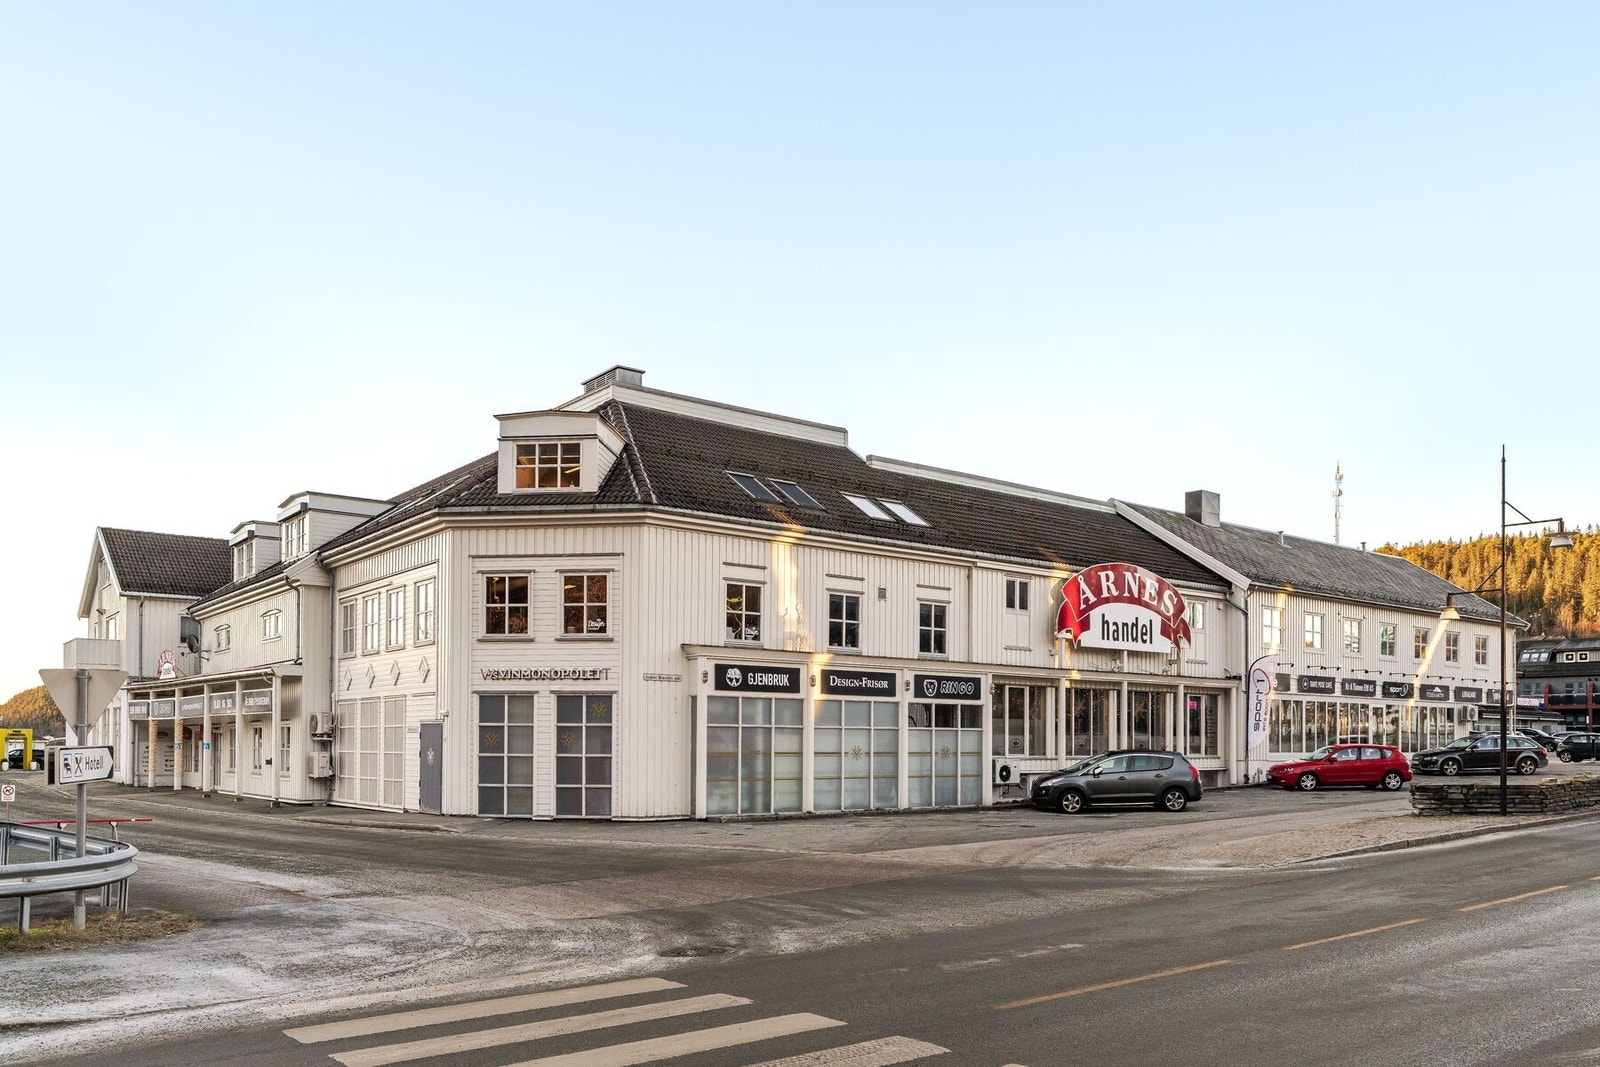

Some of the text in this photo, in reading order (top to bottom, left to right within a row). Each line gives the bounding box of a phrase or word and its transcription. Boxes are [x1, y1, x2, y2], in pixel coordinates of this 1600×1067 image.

[1078, 570, 1178, 616] ÅRNES
[1101, 613, 1153, 645] handel
[494, 667, 611, 681] VINMONOPOLET
[747, 672, 790, 687] GJENBRUK
[940, 681, 975, 695] RINGO
[1253, 689, 1264, 732] sport
[84, 755, 104, 771] Hotell
